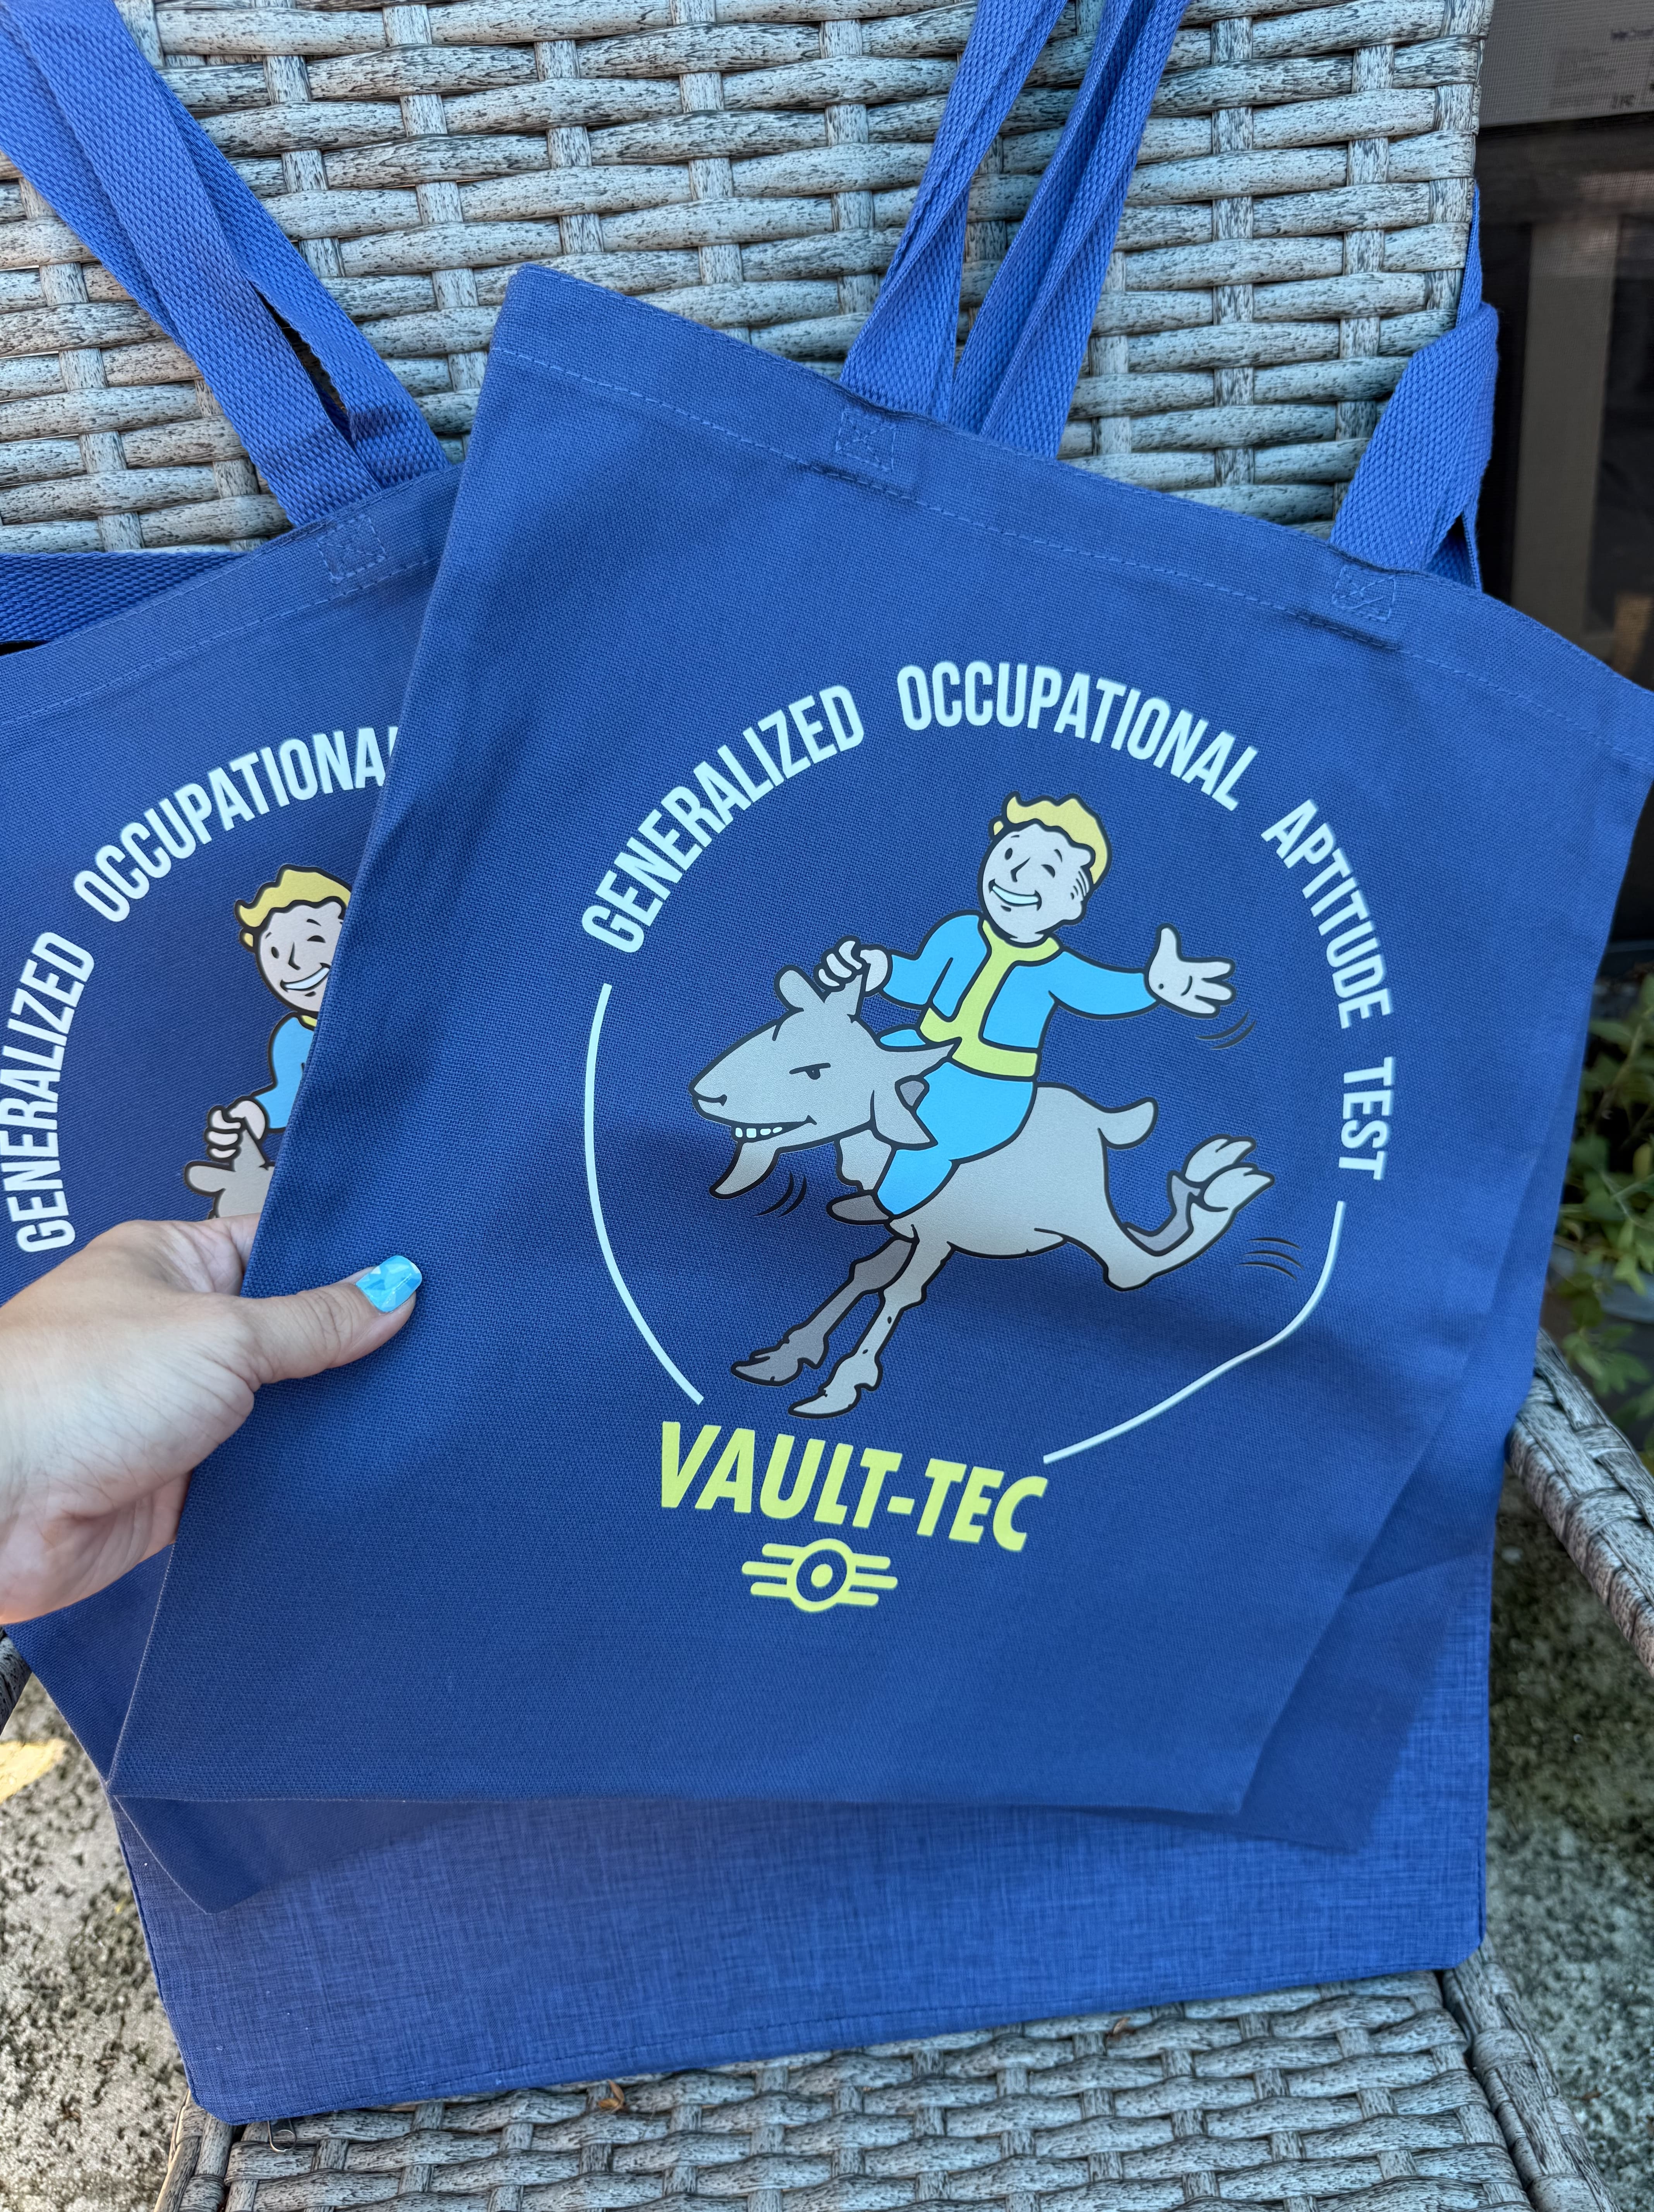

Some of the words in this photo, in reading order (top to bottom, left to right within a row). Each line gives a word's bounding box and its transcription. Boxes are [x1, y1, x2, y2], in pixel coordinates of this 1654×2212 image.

[581, 685, 864, 953] GENERALIZED
[896, 661, 1258, 811] OCCUPATIONAL
[1260, 799, 1391, 1029] APTITUDE
[1338, 1056, 1394, 1180] TEST
[0, 932, 94, 1252] GENERALIZED
[661, 1421, 1048, 1551] VAULT-TEC
